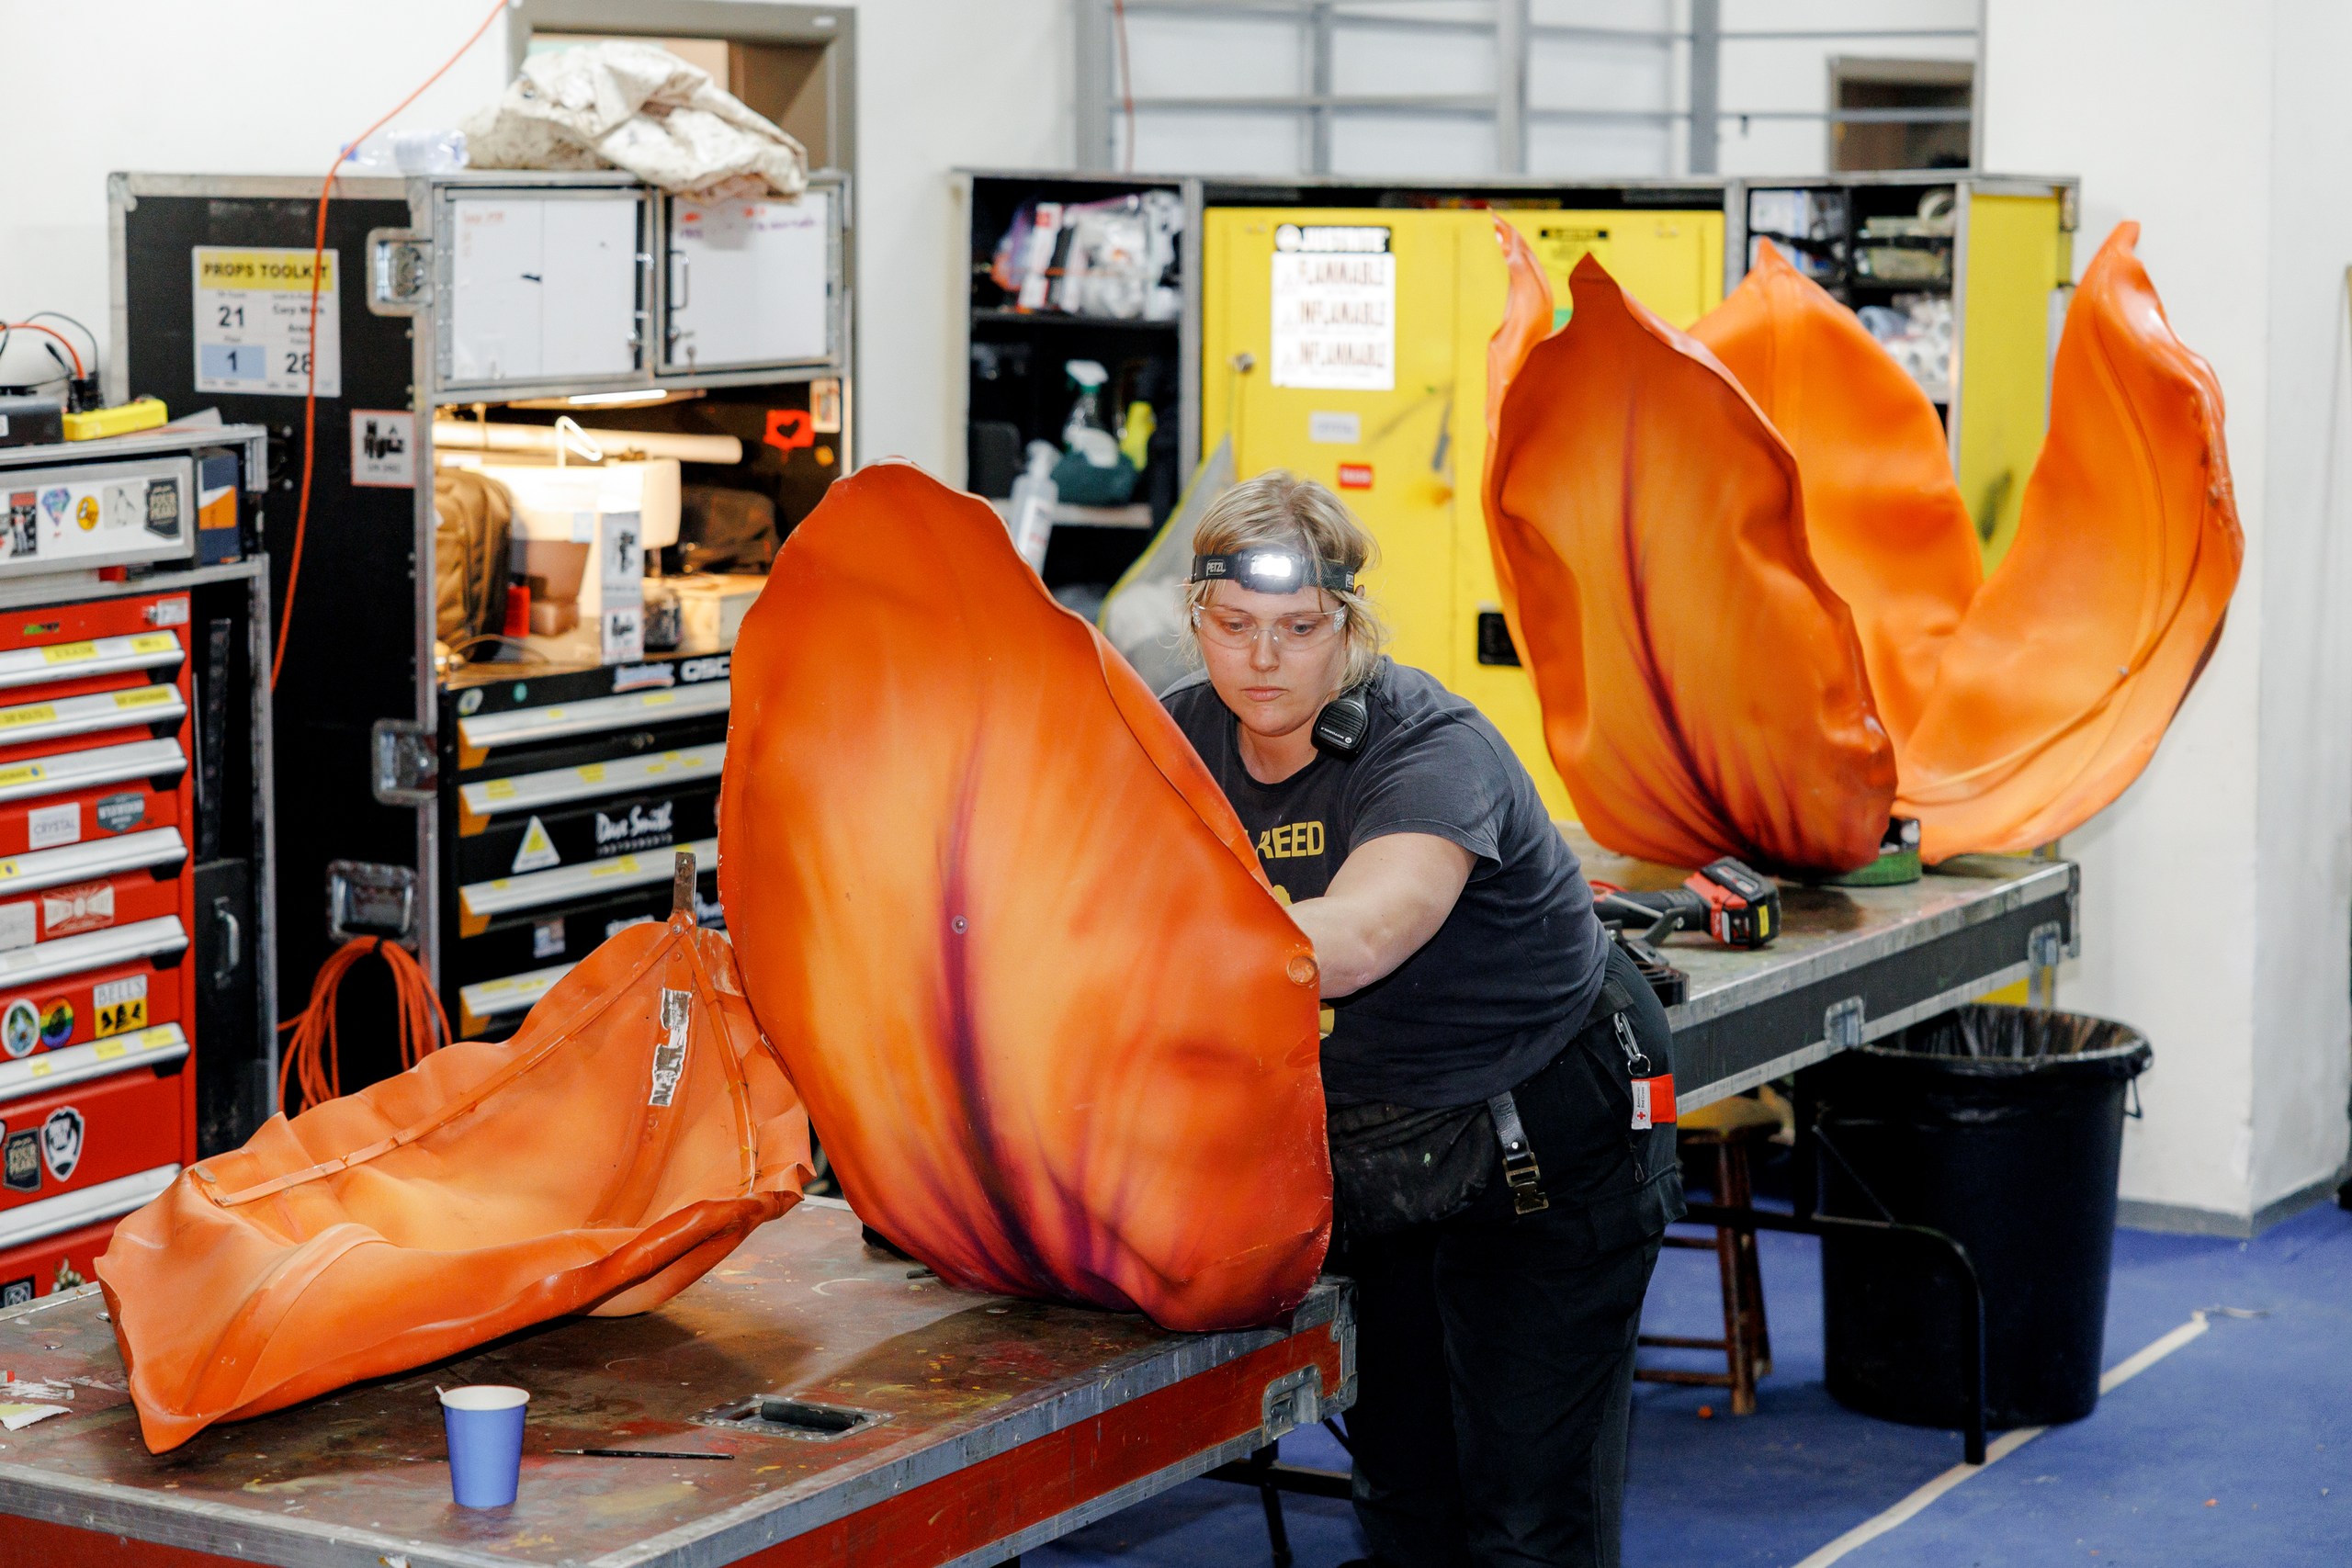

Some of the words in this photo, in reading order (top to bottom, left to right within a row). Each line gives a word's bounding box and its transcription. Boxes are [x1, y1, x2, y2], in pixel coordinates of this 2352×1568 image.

[203, 262, 254, 276] PROPS
[260, 264, 328, 279] TOOLKT
[219, 305, 244, 328] 21
[228, 350, 238, 373] 1
[286, 352, 312, 375] 28
[1205, 561, 1227, 577] PETZL
[1244, 820, 1325, 859] REED
